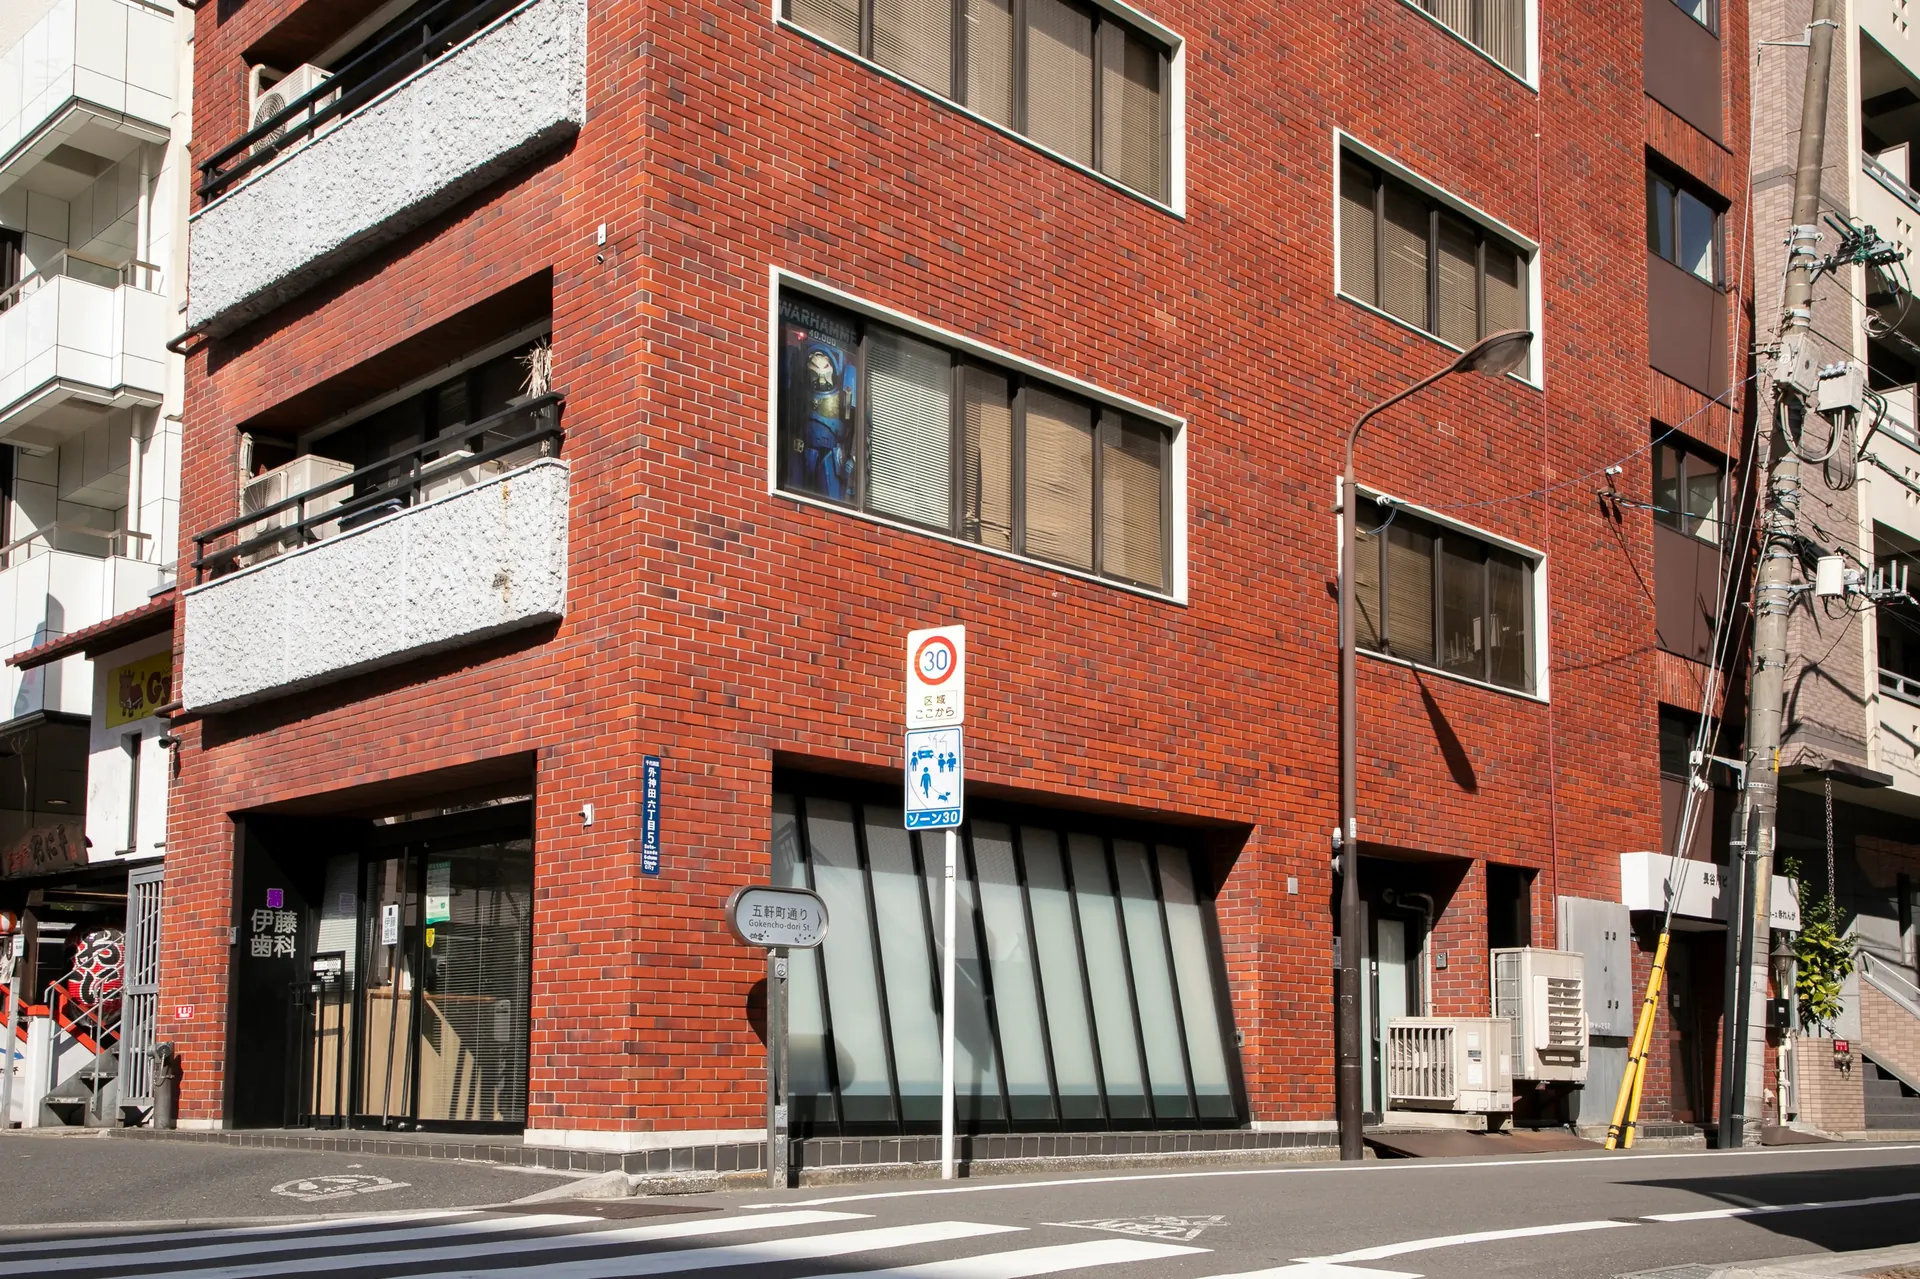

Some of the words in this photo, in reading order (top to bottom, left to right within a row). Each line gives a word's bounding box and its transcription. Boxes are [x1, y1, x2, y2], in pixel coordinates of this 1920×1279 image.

[924, 649, 948, 672] 30
[915, 706, 955, 720] ここから
[908, 811, 958, 826] ゾーン30
[752, 904, 808, 921] 五軒町通り
[251, 909, 298, 934] 伊藤
[748, 919, 801, 931] Gokencho-dori
[803, 923, 813, 931] St.
[250, 933, 297, 959] 歯科
